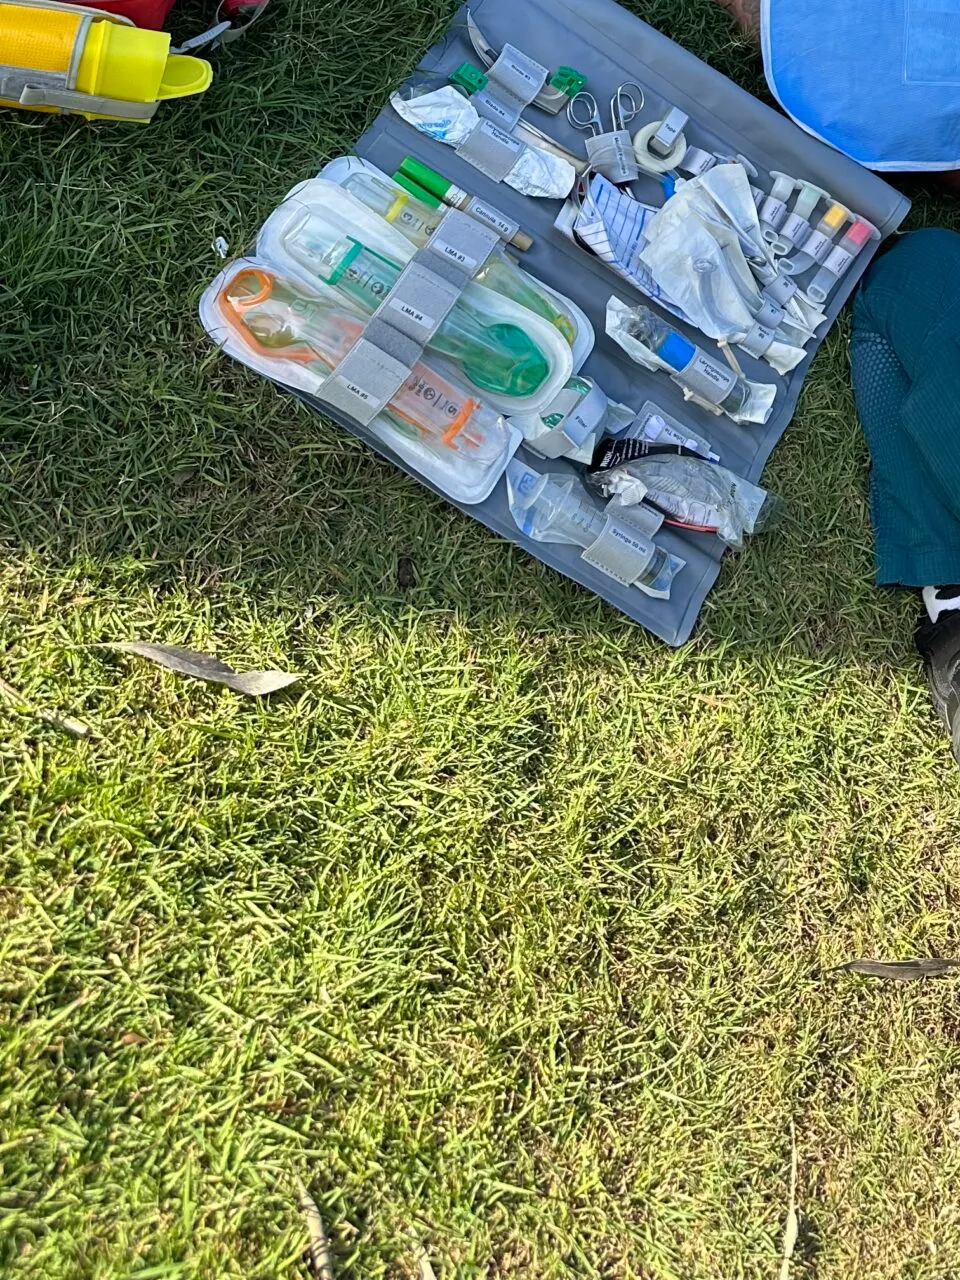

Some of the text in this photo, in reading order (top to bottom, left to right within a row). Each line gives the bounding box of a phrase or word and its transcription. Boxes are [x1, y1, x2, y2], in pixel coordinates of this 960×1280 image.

[665, 123, 677, 134] Tape
[475, 206, 496, 225] Cannula
[444, 245, 466, 263] LMA #3
[400, 304, 424, 322] LMA #4
[703, 369, 720, 383] Handle
[346, 383, 369, 401] LMA #5
[612, 527, 633, 546] Syringe
